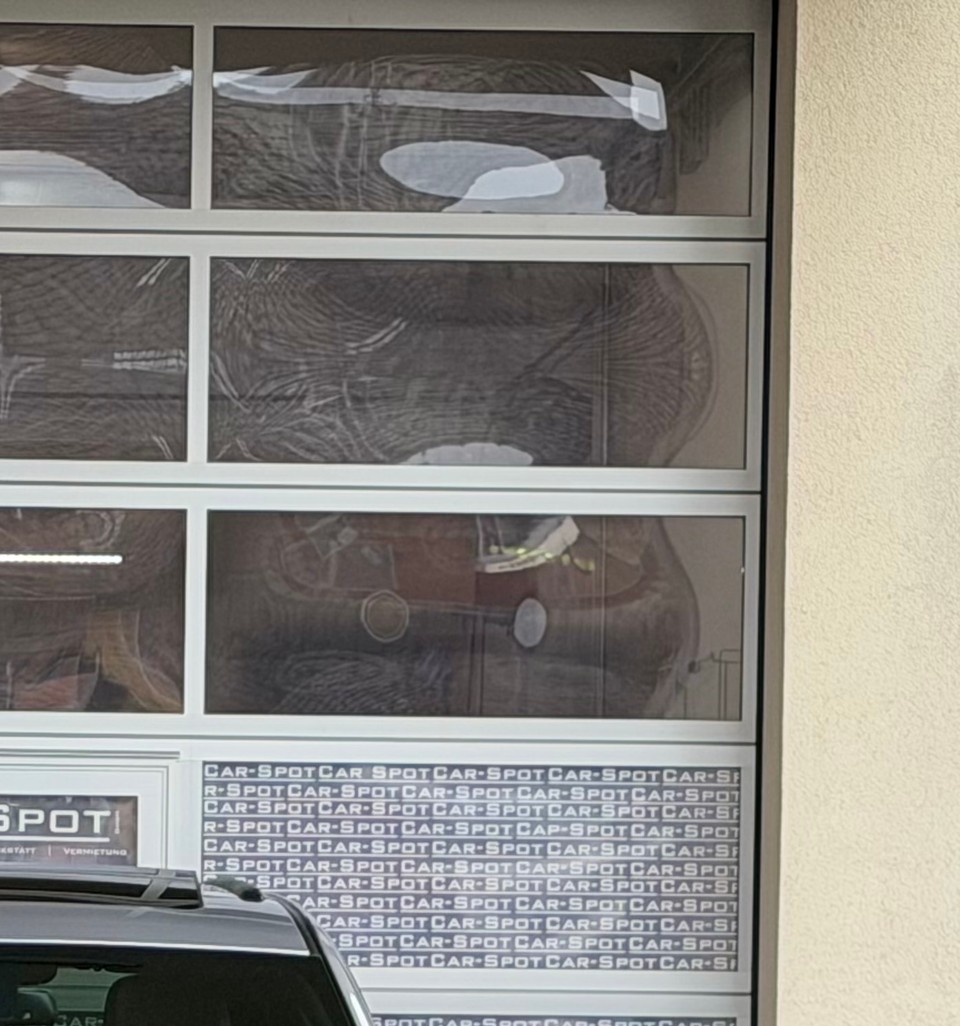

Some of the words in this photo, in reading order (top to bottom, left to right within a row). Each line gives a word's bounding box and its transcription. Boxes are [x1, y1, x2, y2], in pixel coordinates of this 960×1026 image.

[205, 764, 316, 778] CAR-SPOT
[433, 766, 545, 780] CAR-SPOT
[548, 767, 660, 781] CAR-SPOT
[205, 783, 285, 796] R-SPOT
[288, 784, 400, 798] CAR-SPOT
[402, 785, 514, 799] CAR-SPOT
[517, 786, 629, 800] CAR-SPOT
[204, 800, 316, 814] CAR-SPOT
[318, 801, 430, 815] CAR-SPOT
[433, 802, 545, 816] CAR-SPOT
[547, 803, 660, 818] CAR-SPOT
[204, 819, 285, 832] R-SPOT
[287, 820, 399, 834] CAR-SPOT
[402, 821, 514, 835] CAR-SPOT
[204, 838, 315, 852] CAR-SPOT
[318, 839, 430, 853] CAR-SPOT
[432, 841, 545, 855] CAR-SPOT
[547, 842, 659, 856] CAR-SPOT
[204, 857, 284, 871] R-SPOT
[287, 858, 399, 872] CAR-SPOT
[401, 859, 514, 873] CAR-SPOT
[516, 861, 628, 875] CAR-SPOT
[317, 875, 430, 889] CAR-SPOT
[432, 877, 544, 891] CAR-SPOT
[547, 878, 659, 892] CAR-SPOT
[401, 895, 513, 909] CAR-SPOT
[516, 897, 628, 911] CAR-SPOT
[432, 915, 544, 929] CAR-SPOT
[546, 916, 659, 930] CAR-SPOT
[401, 934, 513, 948] CAR-SPOT
[515, 935, 628, 949] CAR-SPOT
[431, 953, 544, 967] CAR-SPOT
[546, 955, 658, 969] CAR-SPOT
